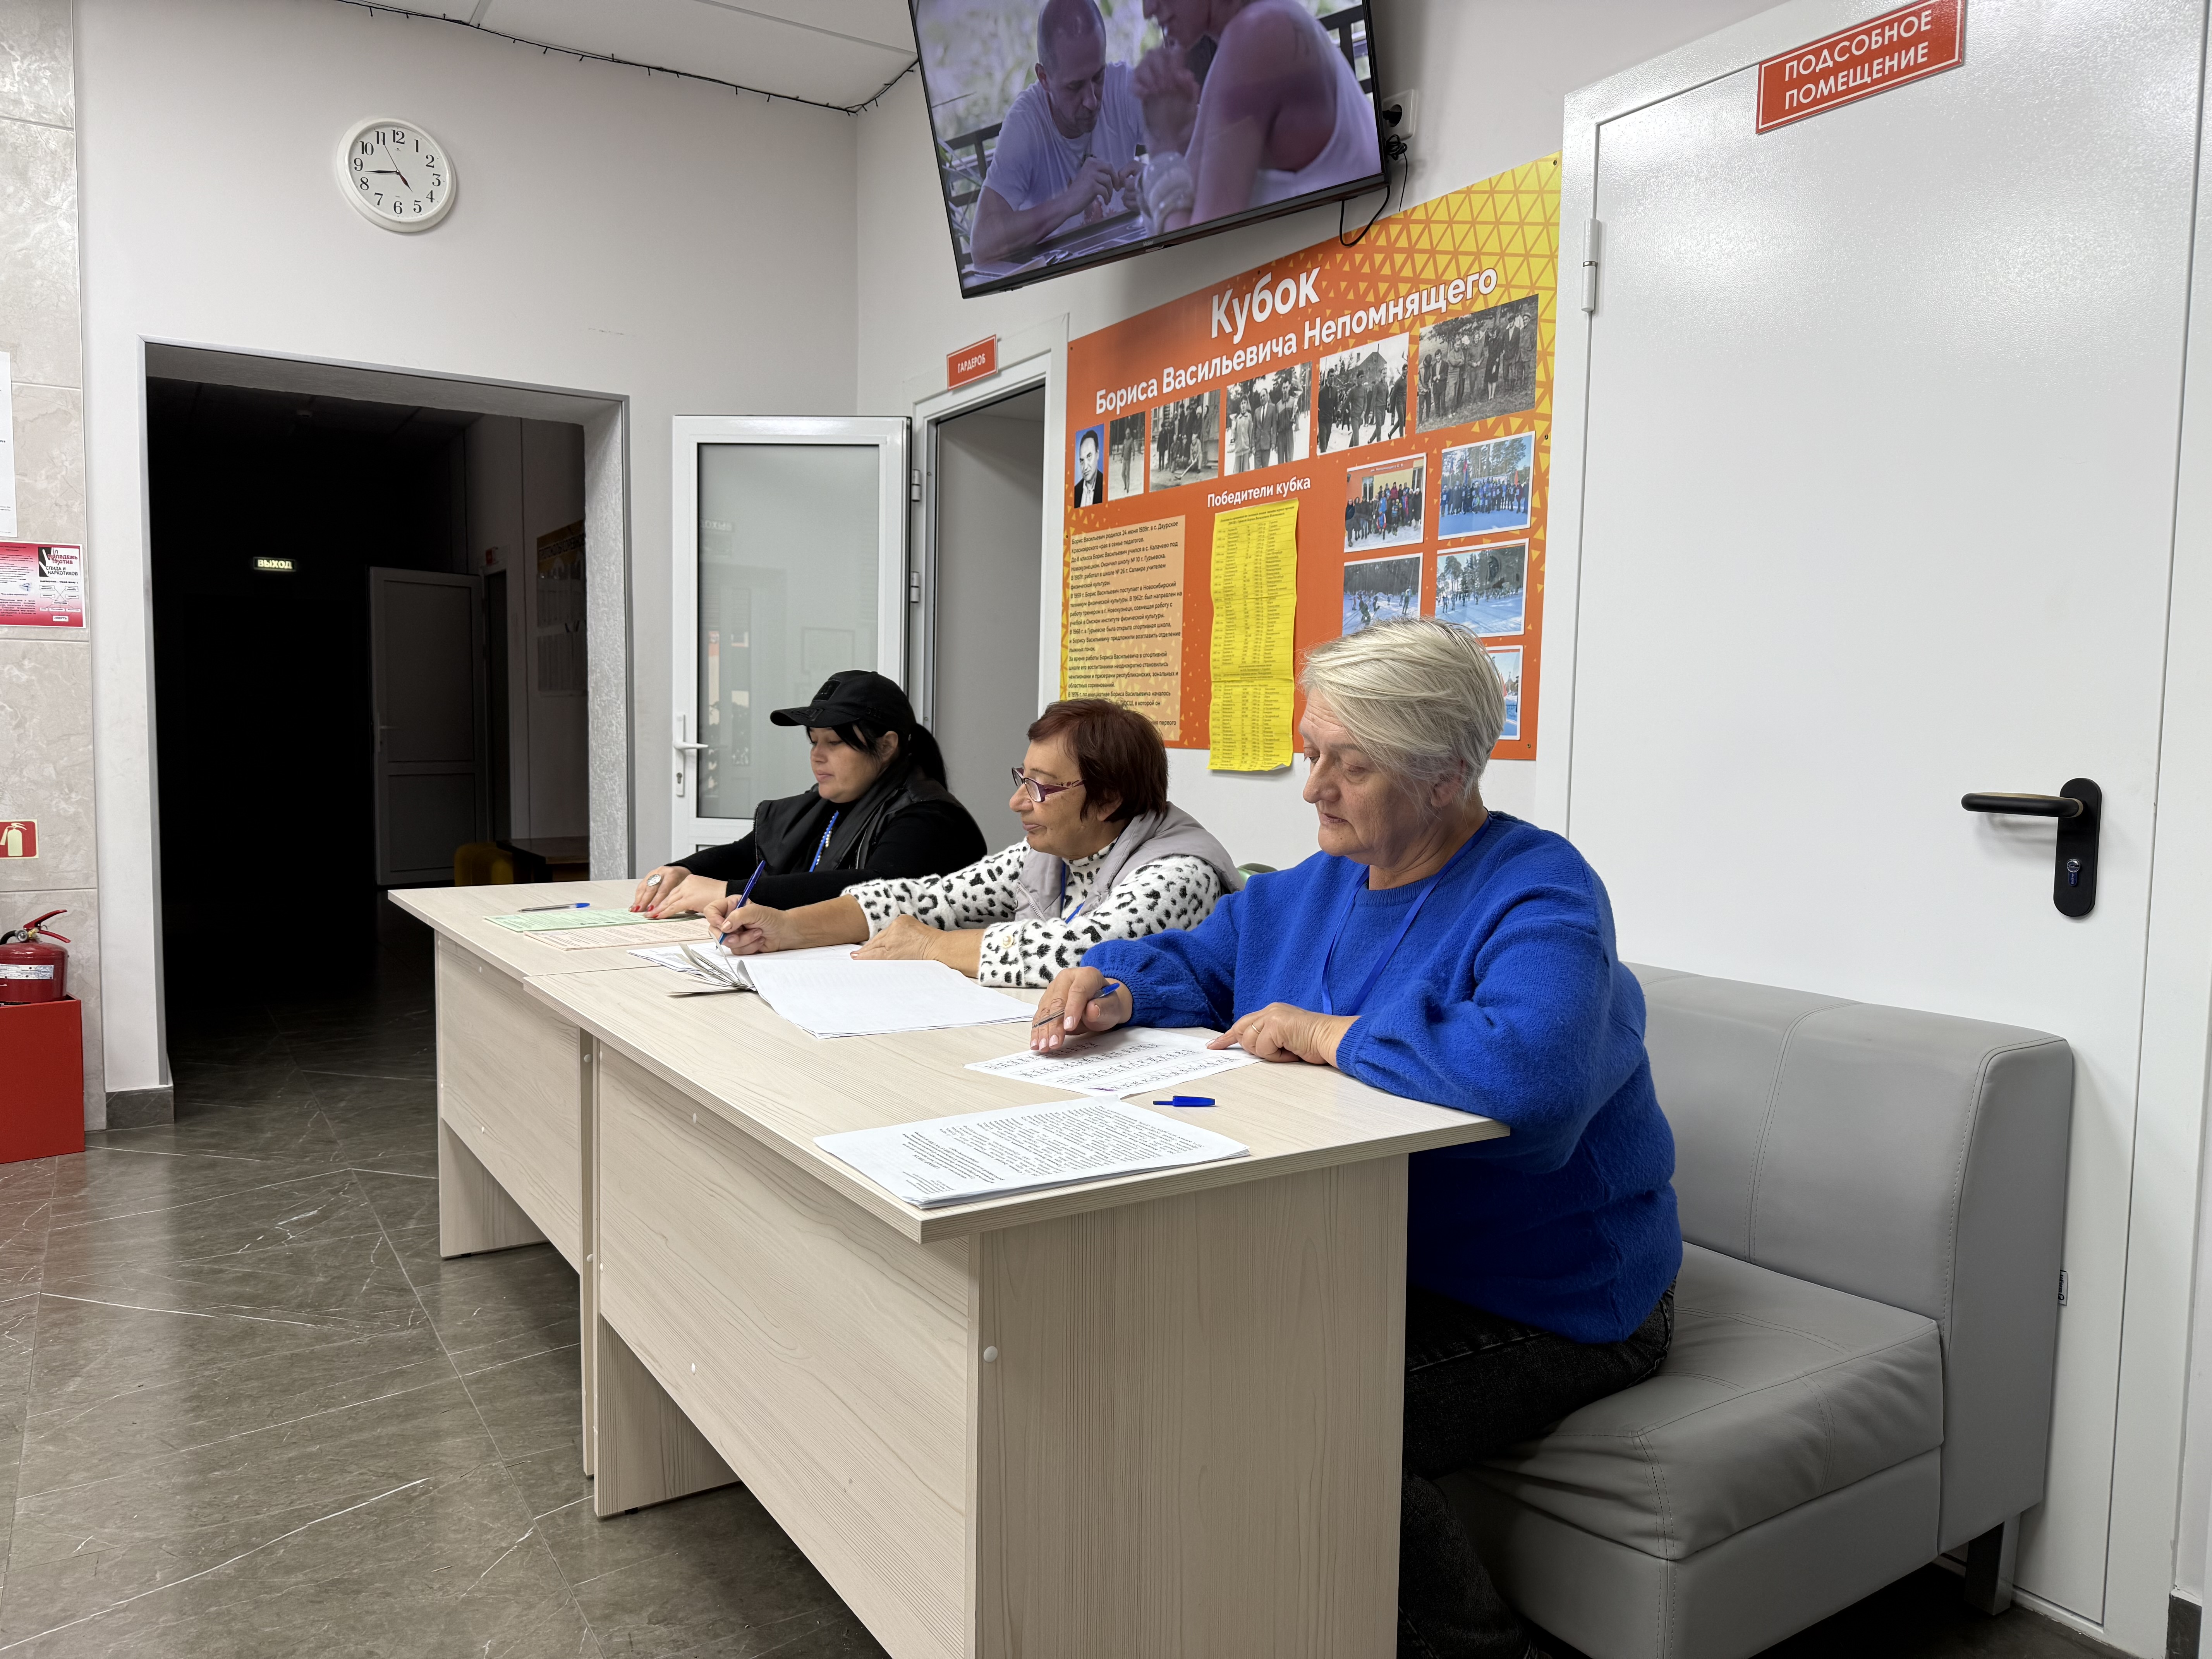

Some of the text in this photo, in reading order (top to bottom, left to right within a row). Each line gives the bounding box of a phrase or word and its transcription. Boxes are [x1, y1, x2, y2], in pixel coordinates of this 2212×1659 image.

[1785, 10, 1932, 81] ПОДСОБНОЕ
[1785, 41, 1929, 110] ПОМЕЩЕНИЕ
[375, 131, 385, 145] 11
[392, 129, 405, 144] 12
[360, 141, 374, 155] 10
[414, 139, 419, 153] 1
[354, 158, 363, 171] 9
[426, 155, 434, 168] 2
[360, 177, 369, 190] 8
[432, 173, 441, 186] 3
[374, 192, 383, 206] 7
[426, 190, 434, 203] 4
[393, 201, 402, 214] 6
[413, 200, 422, 213] 5
[1211, 267, 1321, 344] Кубок
[1096, 267, 1498, 415] Бориса Васильевича Непомнящего
[958, 354, 986, 373] ГАРДЕРОБ
[1207, 476, 1310, 507] Победители кубка
[258, 559, 293, 569] ВЫХОД
